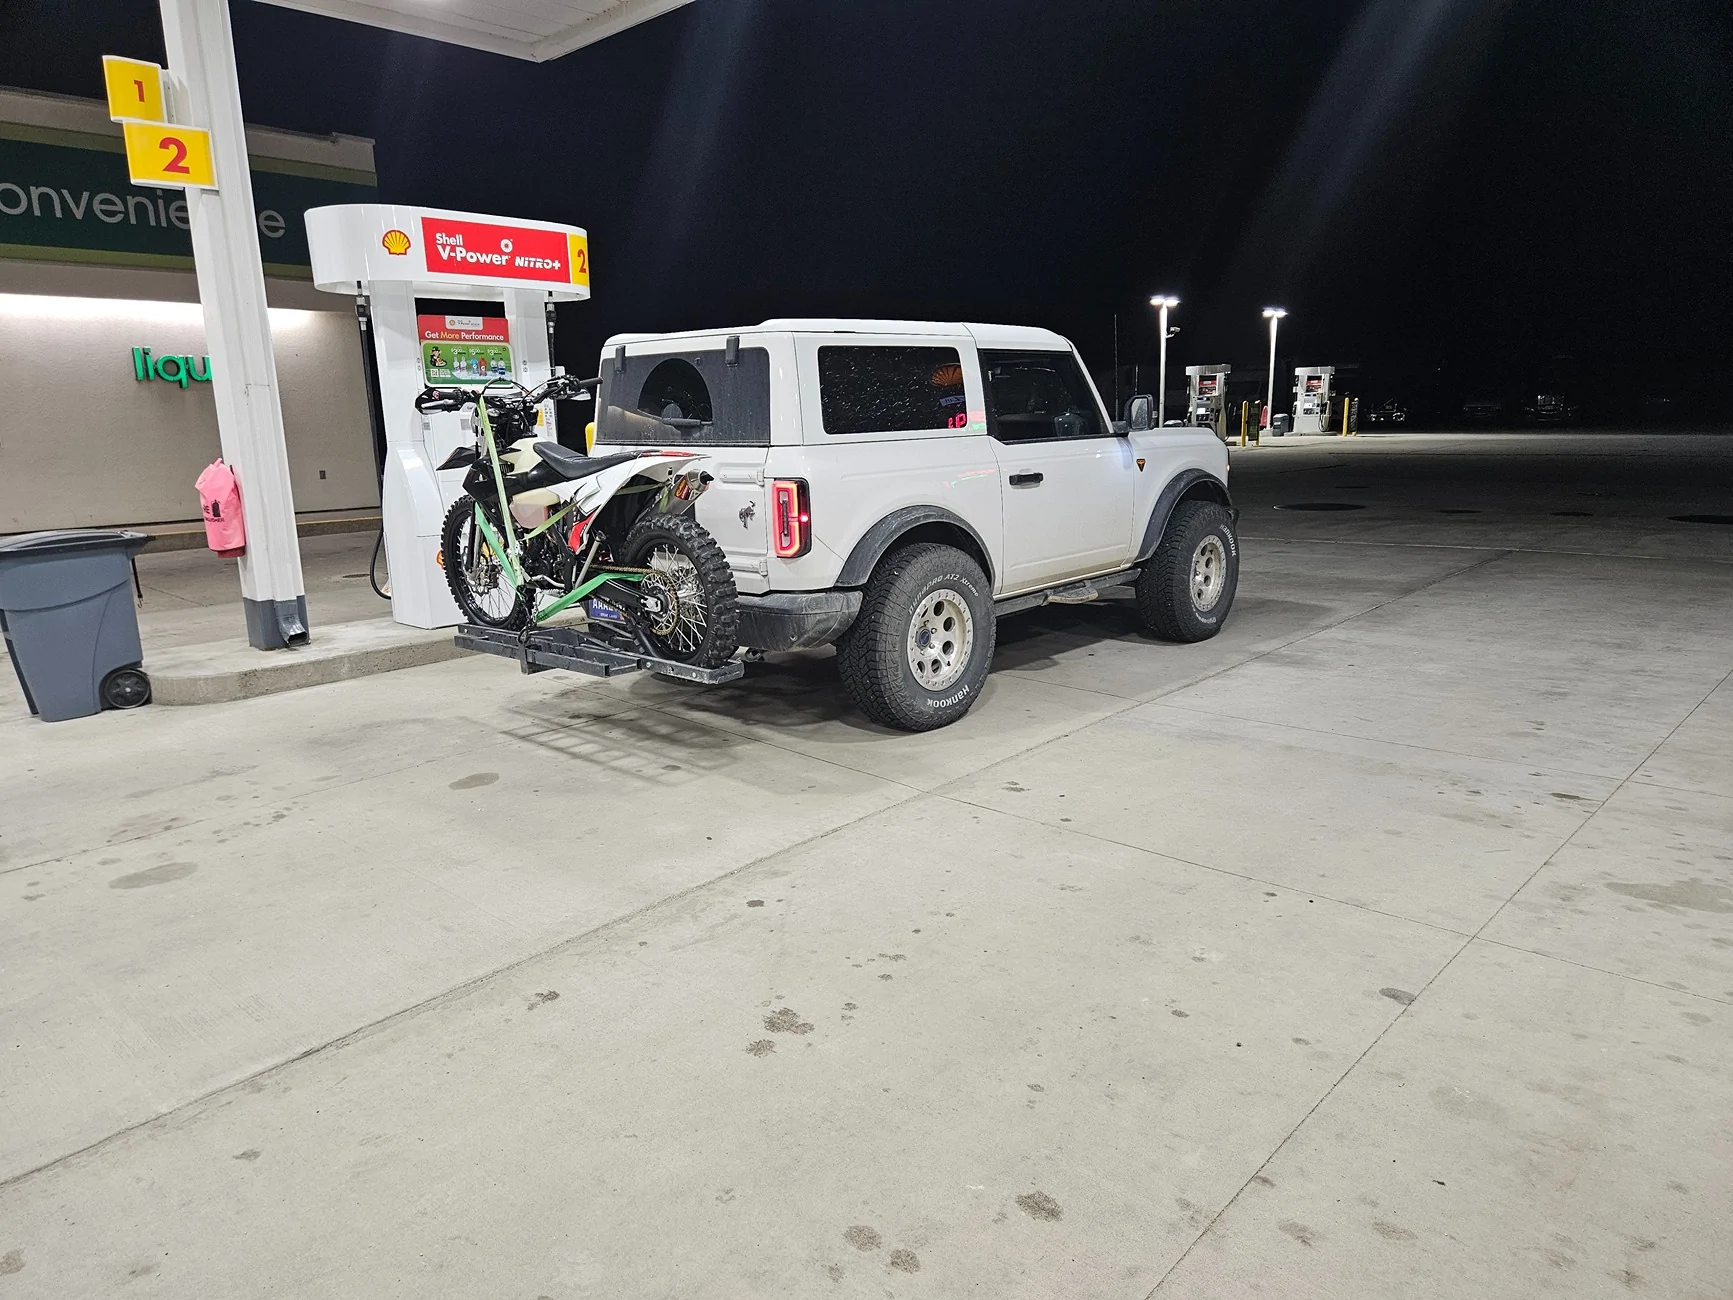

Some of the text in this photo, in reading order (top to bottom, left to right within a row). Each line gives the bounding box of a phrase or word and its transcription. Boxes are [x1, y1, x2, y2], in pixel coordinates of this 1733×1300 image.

[133, 79, 146, 103] 1
[158, 136, 191, 175] 2
[435, 232, 464, 246] Shell
[436, 245, 509, 266] V-Power
[577, 248, 587, 274] 2
[424, 330, 504, 341] Get More Performance
